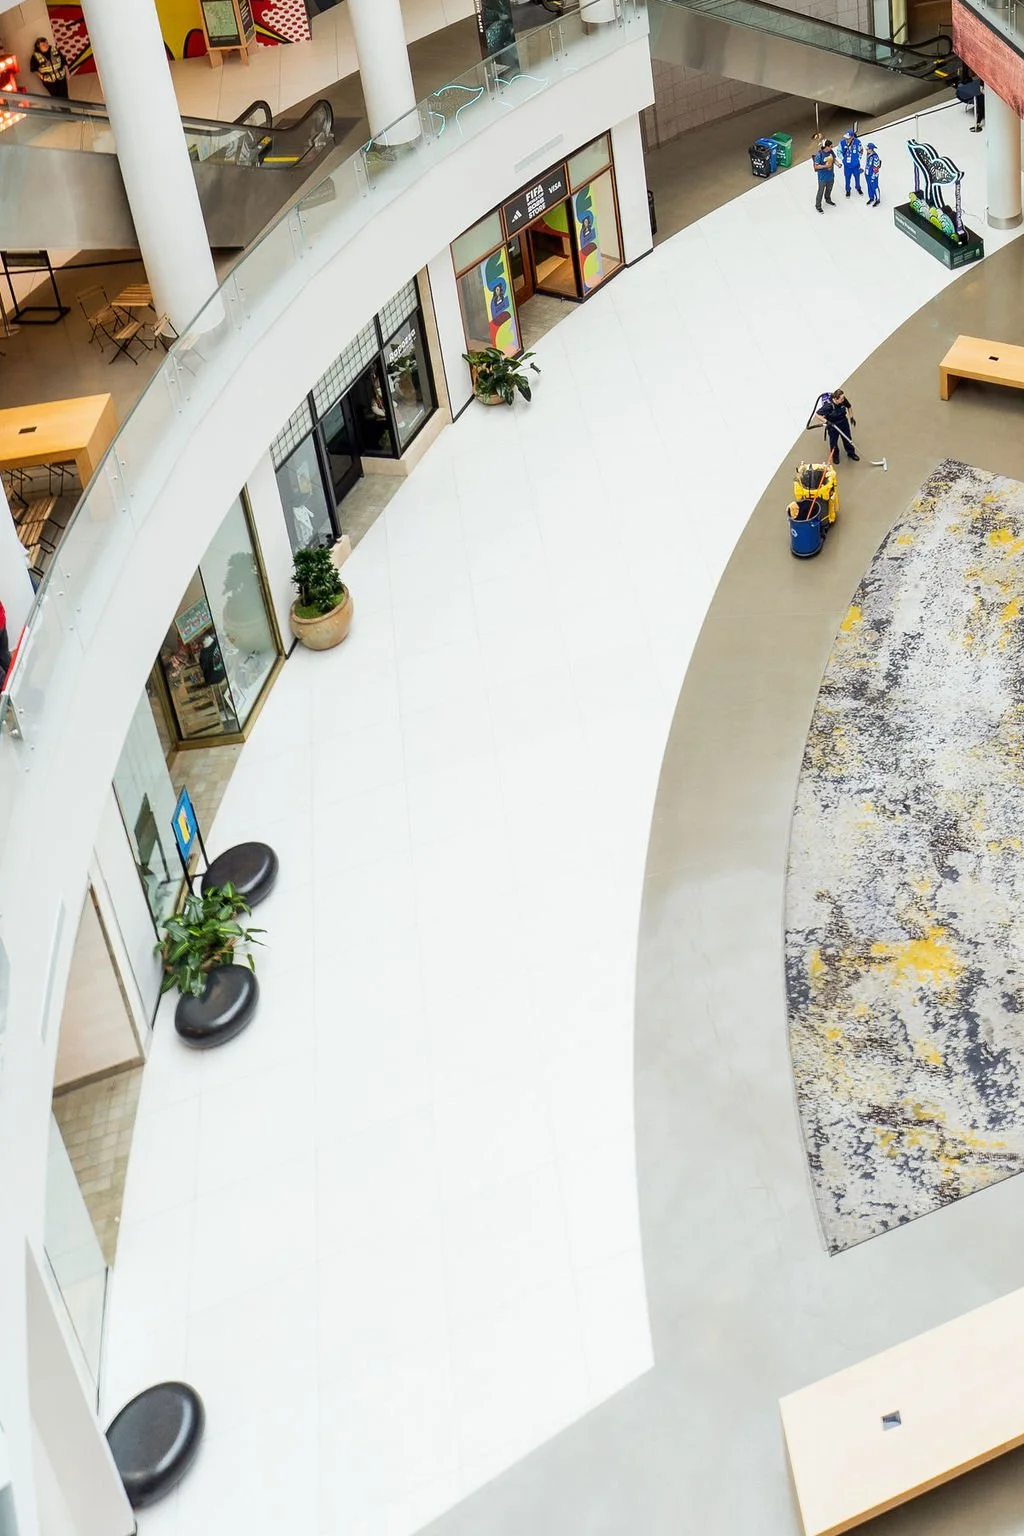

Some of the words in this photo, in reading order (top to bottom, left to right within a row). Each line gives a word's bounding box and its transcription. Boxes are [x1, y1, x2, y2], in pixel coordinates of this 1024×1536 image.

[526, 184, 544, 203] FIFA
[548, 181, 562, 194] VISA
[527, 197, 545, 213] 2026
[528, 202, 546, 219] STORE
